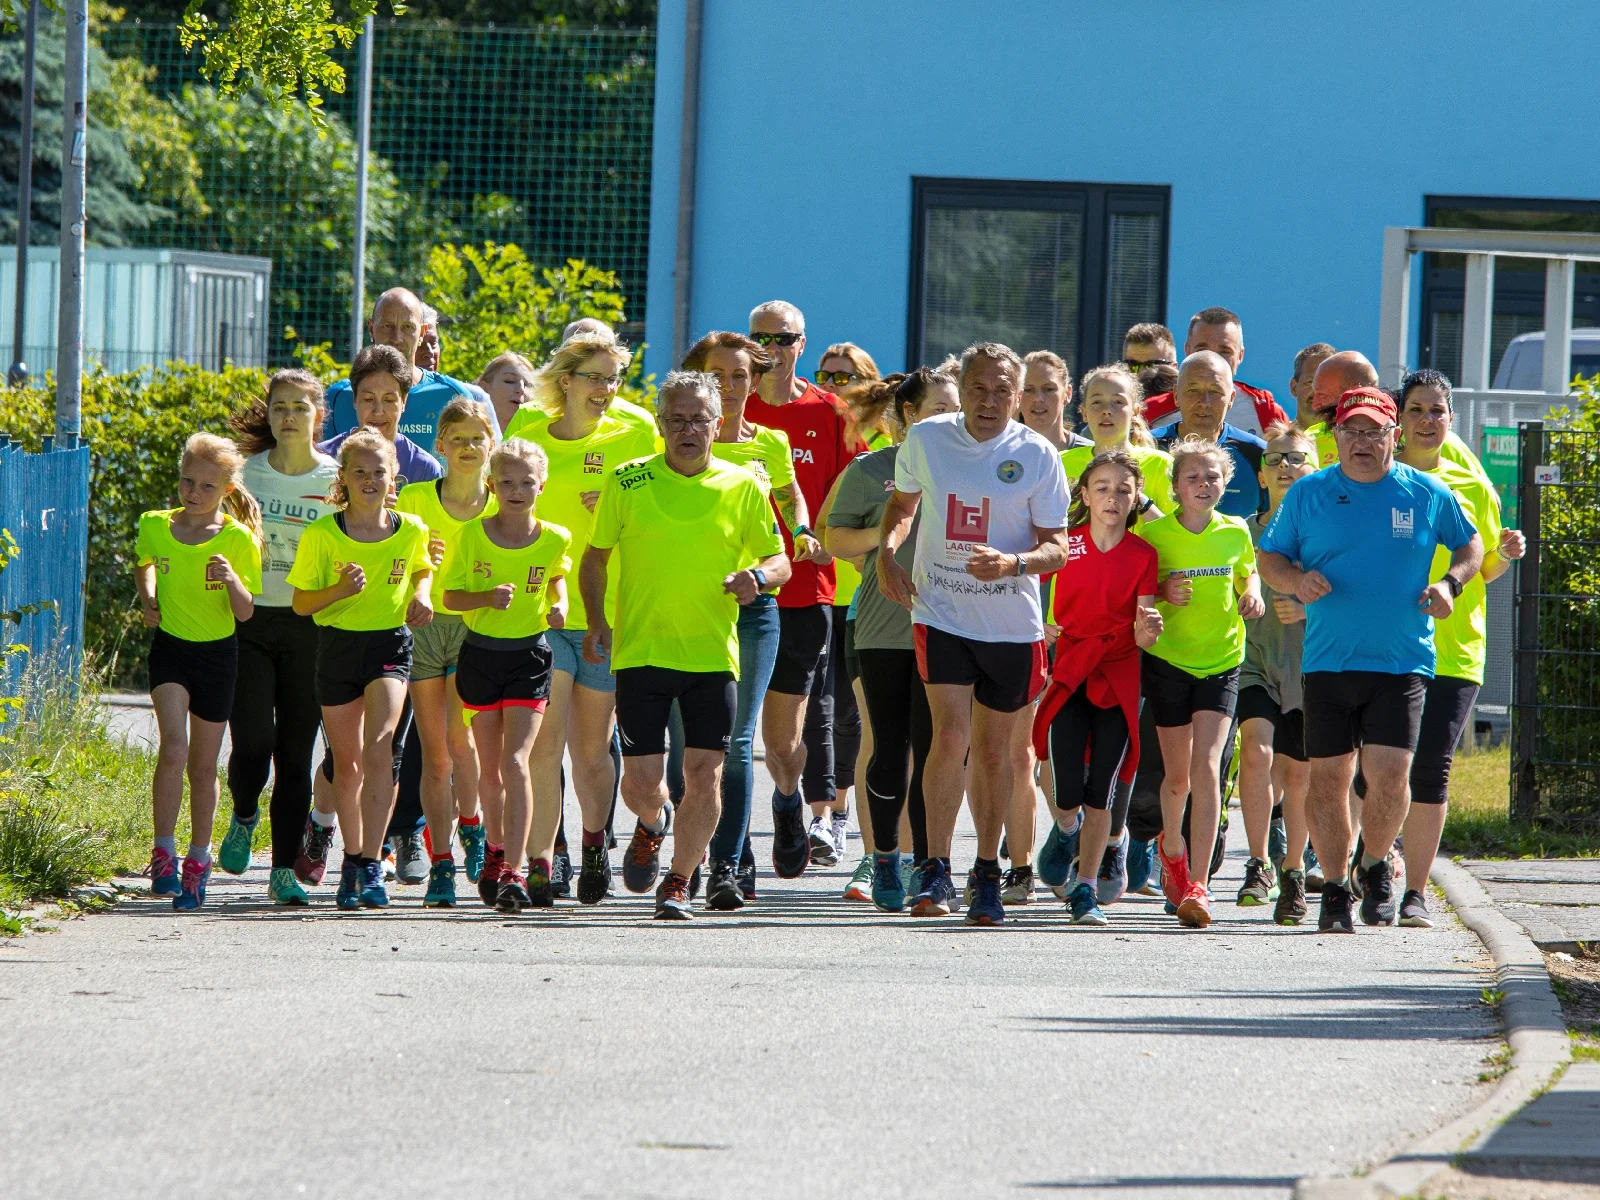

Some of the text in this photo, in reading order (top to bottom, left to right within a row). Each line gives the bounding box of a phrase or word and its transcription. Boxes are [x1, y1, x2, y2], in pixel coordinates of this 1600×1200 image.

[792, 448, 814, 464] PA
[1324, 453, 1334, 464] 2
[583, 467, 603, 475] LWG
[884, 479, 896, 492] 2
[945, 542, 987, 552] LAAG
[1068, 545, 1087, 554] ort
[473, 560, 491, 578] 25
[1179, 567, 1231, 579] URAWASSE
[205, 583, 224, 591] LWG
